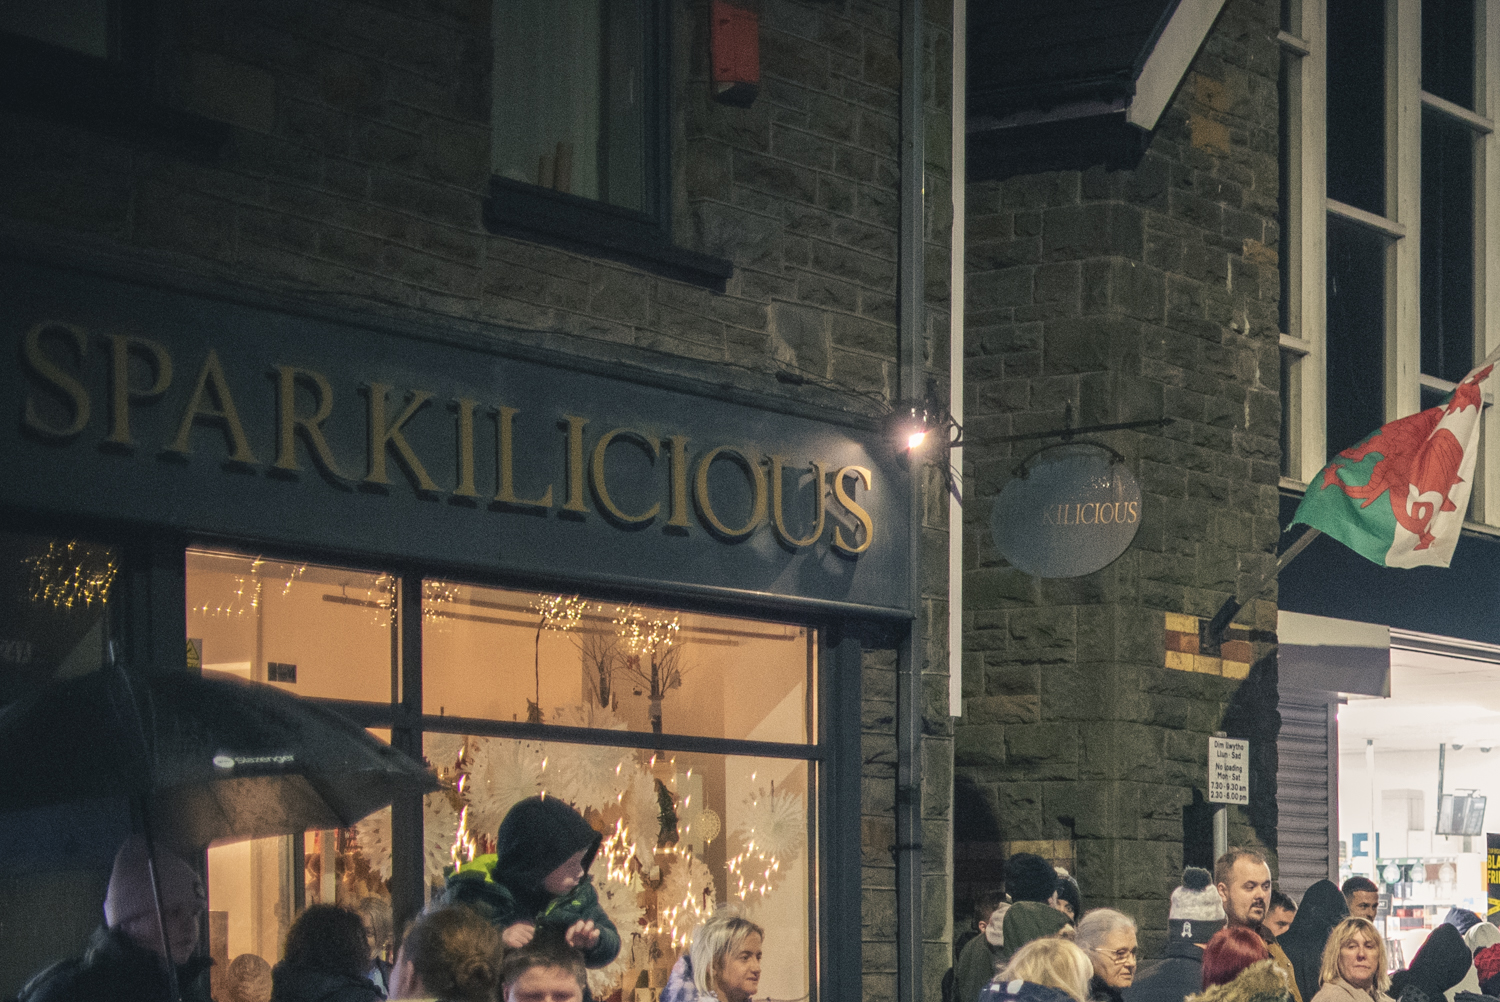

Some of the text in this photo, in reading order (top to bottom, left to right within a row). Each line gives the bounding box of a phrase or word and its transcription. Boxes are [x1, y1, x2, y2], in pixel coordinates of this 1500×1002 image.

[21, 319, 875, 558] SPARKILICIOUS
[1217, 750, 1228, 758] Llun
[1231, 751, 1241, 759] Sad
[1216, 762, 1242, 773] No loading
[1218, 772, 1228, 780] Mon
[1232, 773, 1241, 781] Sat
[1211, 782, 1223, 790] 7.30
[1211, 791, 1223, 799] 2.30
